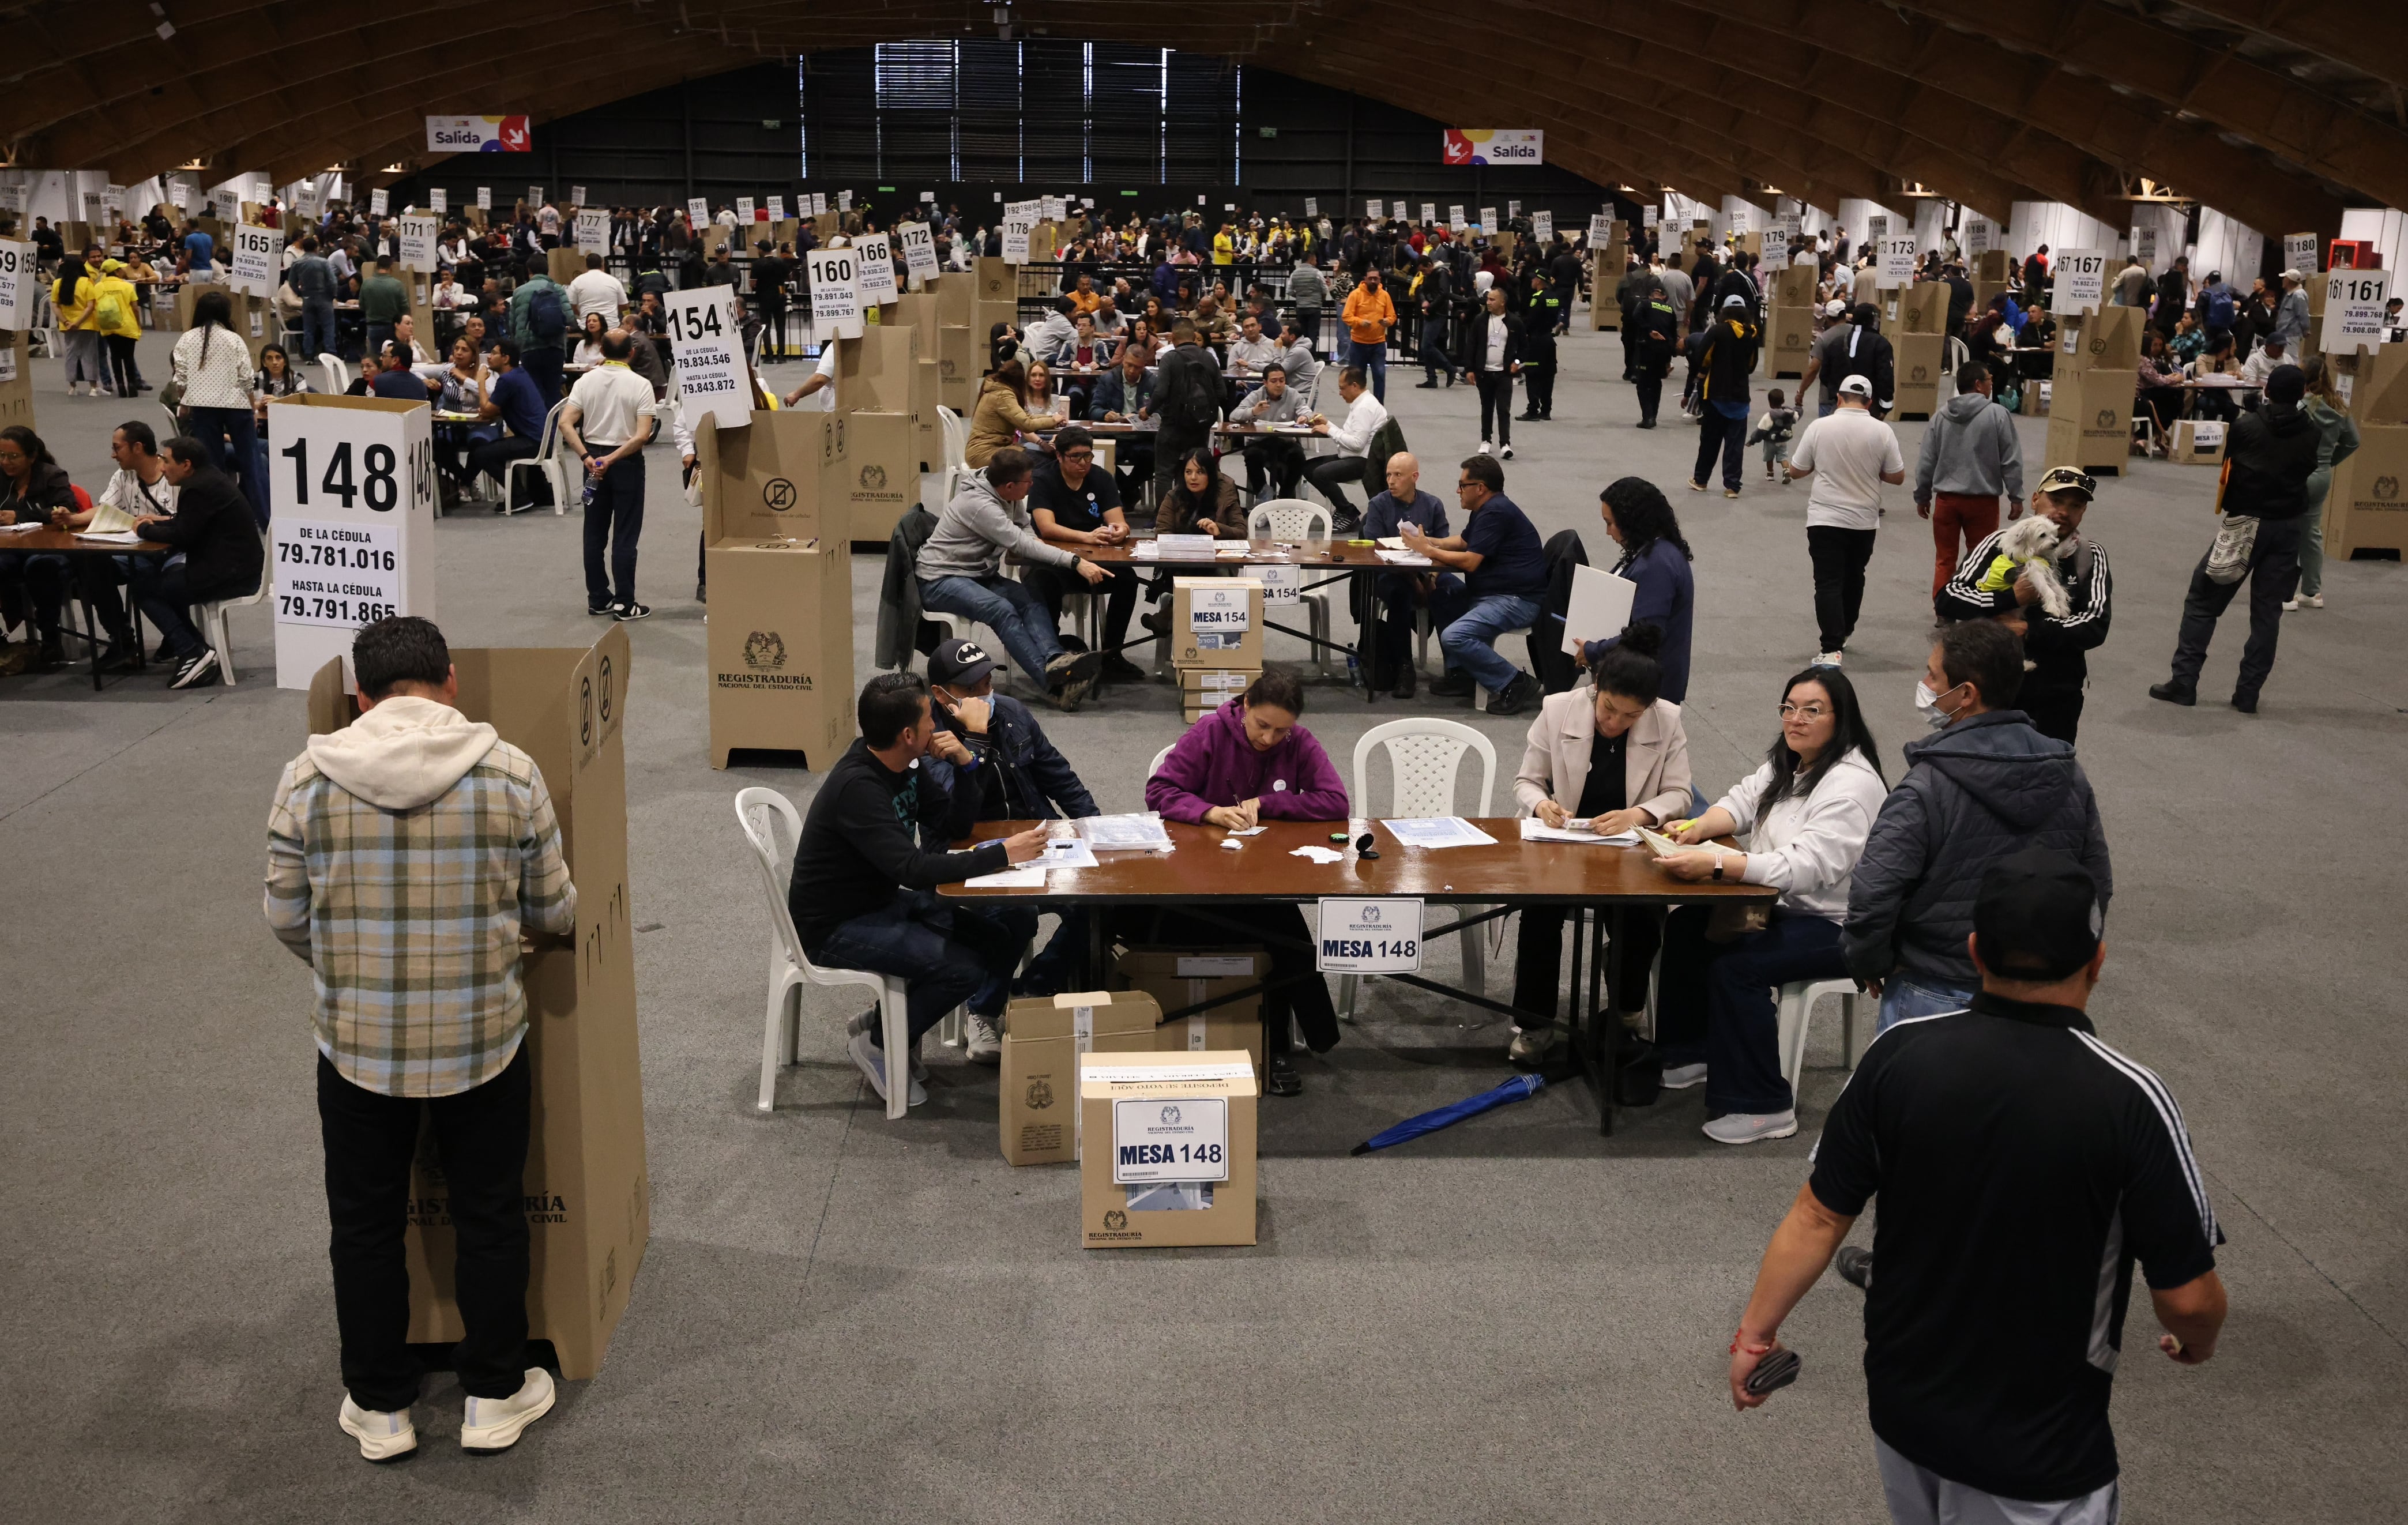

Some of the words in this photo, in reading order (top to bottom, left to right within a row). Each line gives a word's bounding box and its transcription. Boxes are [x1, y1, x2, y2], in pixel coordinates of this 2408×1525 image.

[435, 130, 480, 144] Salida
[1493, 145, 1536, 157] Salida
[691, 202, 703, 210] 191
[738, 200, 750, 208] 197
[580, 214, 600, 227] 177
[1537, 214, 1550, 223] 193
[1595, 219, 1609, 228] 187
[402, 222, 422, 236] 171
[1010, 223, 1028, 234] 178
[1666, 223, 1678, 232] 183
[904, 230, 929, 246] 172
[1766, 230, 1785, 243] 179
[2143, 231, 2154, 240] 184
[239, 233, 269, 253] 165
[272, 238, 283, 254] 165
[1878, 241, 1887, 254] 173
[1891, 241, 1914, 254] 173
[2296, 239, 2315, 252] 180
[857, 243, 887, 262] 166
[21, 252, 36, 273] 159
[2057, 256, 2071, 272] 167
[2074, 257, 2102, 273] 167
[812, 259, 851, 283] 160
[859, 267, 889, 276] 79.930.227
[861, 280, 891, 289] 79.932.210
[2329, 278, 2343, 300] 161
[2348, 280, 2383, 301] 161
[814, 292, 853, 300] 79.891.043
[815, 308, 854, 317] 79.899.767
[668, 304, 722, 341] 154
[678, 353, 731, 368] 79.834.546
[682, 379, 735, 394] 79.843.872
[282, 437, 398, 513] 148
[408, 437, 431, 510] 148
[300, 528, 313, 539] DE
[316, 529, 329, 540] LA
[332, 527, 371, 544] CÉDULA
[278, 543, 395, 571] 79.781.016
[292, 579, 325, 593] HASTA
[327, 581, 339, 594] LA
[343, 582, 382, 597] CÉDULA
[1263, 589, 1274, 598] SA
[1276, 588, 1297, 598] 154
[280, 596, 396, 622] 79.791.865
[1194, 612, 1222, 623] MESA
[1224, 612, 1246, 622] 154
[718, 673, 812, 685] REGISTRADURÍA
[1323, 940, 1373, 958] MESA
[1378, 940, 1416, 957] 148
[1120, 1144, 1175, 1165] MESA
[1180, 1143, 1222, 1163] 148
[531, 1214, 567, 1223] CIVIL
